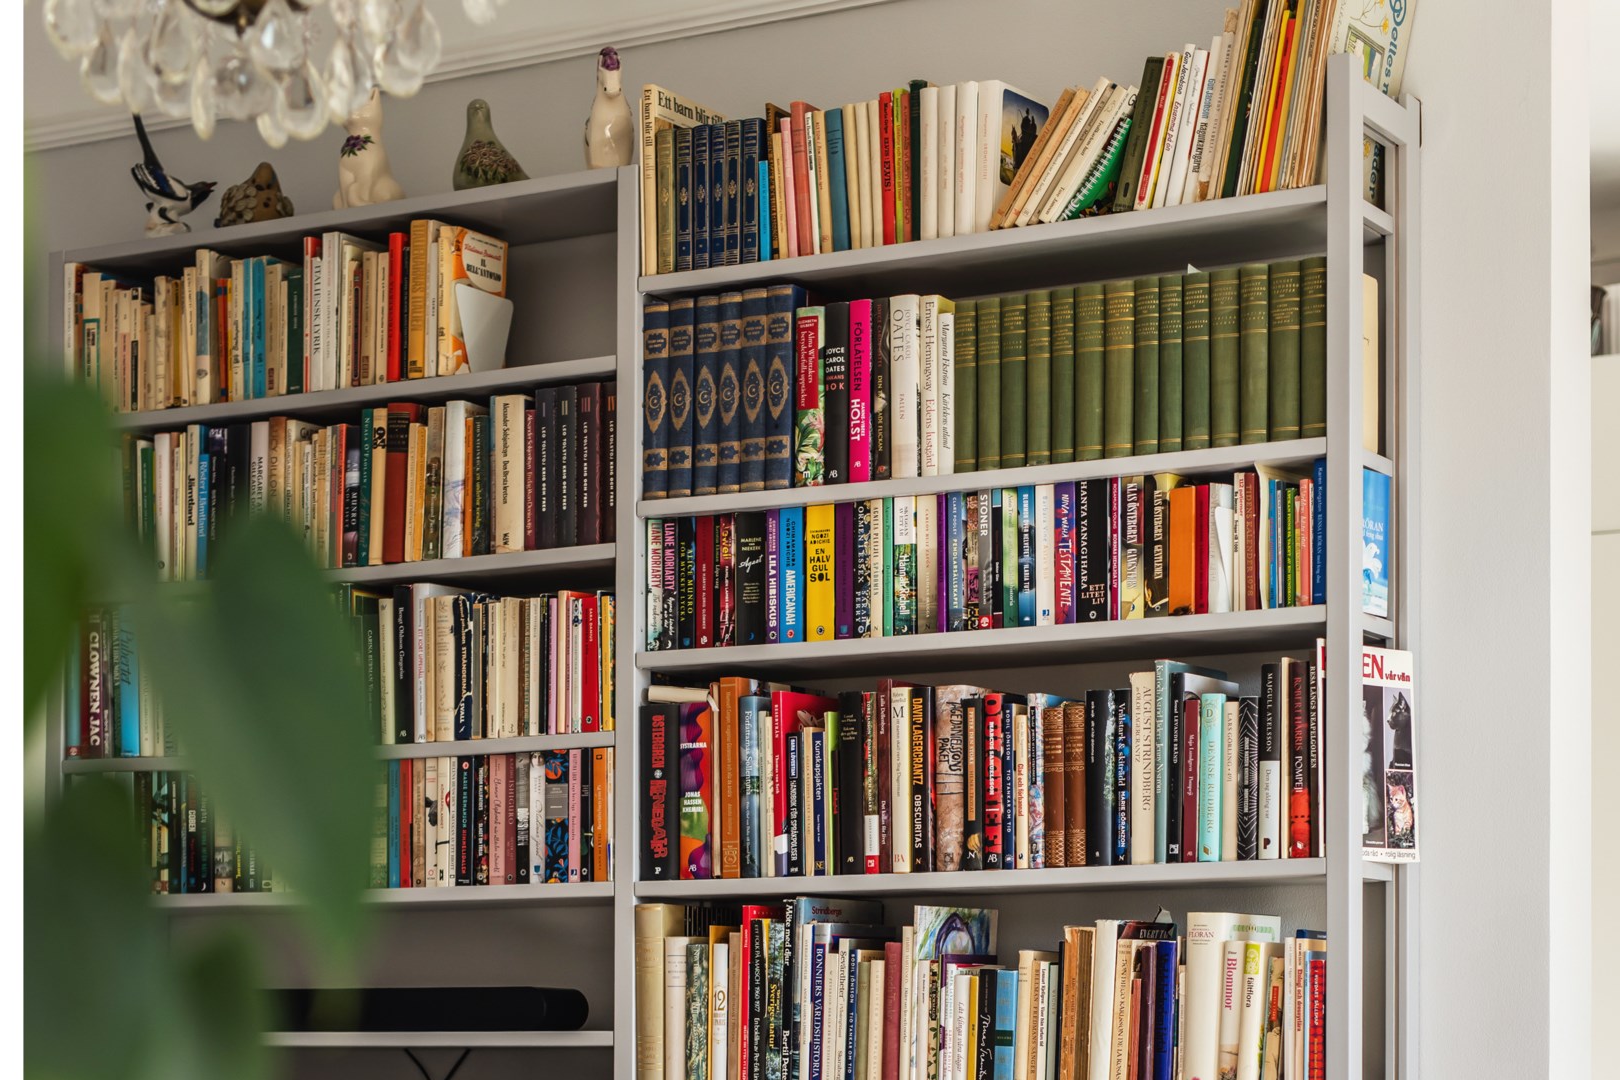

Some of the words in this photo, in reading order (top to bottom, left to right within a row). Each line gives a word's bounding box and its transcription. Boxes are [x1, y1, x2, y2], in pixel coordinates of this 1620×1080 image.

[644, 89, 652, 101] Ett
[1177, 64, 1189, 95] Jacobson
[644, 102, 652, 120] barn
[657, 91, 673, 107] Ett
[674, 96, 693, 118] barn
[1169, 101, 1182, 132] Ensamma
[645, 136, 653, 147] till
[313, 265, 321, 320] ITALIENSK
[924, 301, 934, 332] Ernest
[313, 324, 321, 354] LYRIK
[807, 331, 815, 347] Alma
[893, 309, 904, 362] OATES
[807, 348, 815, 383] Whittakers
[854, 322, 863, 391] FÖRLÅTELSEN
[924, 335, 934, 392] Hemingway
[851, 398, 860, 441] HOLST
[925, 399, 934, 429] Edens
[925, 431, 935, 468] lustgård
[199, 461, 208, 489] Röster
[270, 456, 278, 497] DILLON
[1126, 483, 1137, 502] KLAS
[187, 475, 195, 526] Jämtland
[198, 496, 208, 537] Jämtland
[980, 494, 988, 536] STONER
[1080, 481, 1088, 517] HANYA
[651, 522, 661, 550] LIANE
[664, 523, 674, 551] LIANE
[1126, 502, 1139, 544] ÖSTERGREN
[651, 552, 662, 588] MORIARTY
[664, 553, 675, 590] MORIARTY
[768, 555, 777, 576] LILA
[810, 573, 830, 582] SOL
[899, 554, 909, 586] Hannah
[1058, 539, 1072, 607] TESTAMENTE
[786, 570, 796, 625] AMERICANAH
[899, 587, 909, 615] Richell
[89, 632, 100, 713] CLOWNEN
[1385, 672, 1396, 680] vår
[1397, 673, 1410, 682] vän
[912, 698, 923, 723] DAVID
[1117, 703, 1126, 741] Vrålstark
[1143, 686, 1151, 731] AUGUST
[90, 716, 100, 746] JAC
[652, 715, 666, 768] ÖSTERGREN
[815, 740, 823, 800] Kunskapsjakten
[912, 725, 924, 785] LAGERCRANTZ
[1142, 734, 1151, 811] STRINDBERG
[1207, 741, 1215, 779] DENISE
[1293, 756, 1303, 793] POMPEJI
[188, 810, 196, 832] COBEN
[914, 794, 922, 848] OBSCURITAS
[1206, 783, 1215, 833] RUDBERG
[783, 948, 791, 966] djur
[815, 948, 823, 996] BONNIERS
[1224, 958, 1237, 1010] Blommor
[1245, 977, 1254, 1008] fältflora
[768, 984, 777, 1022] Sveriges
[782, 1030, 790, 1055] Bertil
[812, 999, 823, 1078] VÄRLDSHISTORIA
